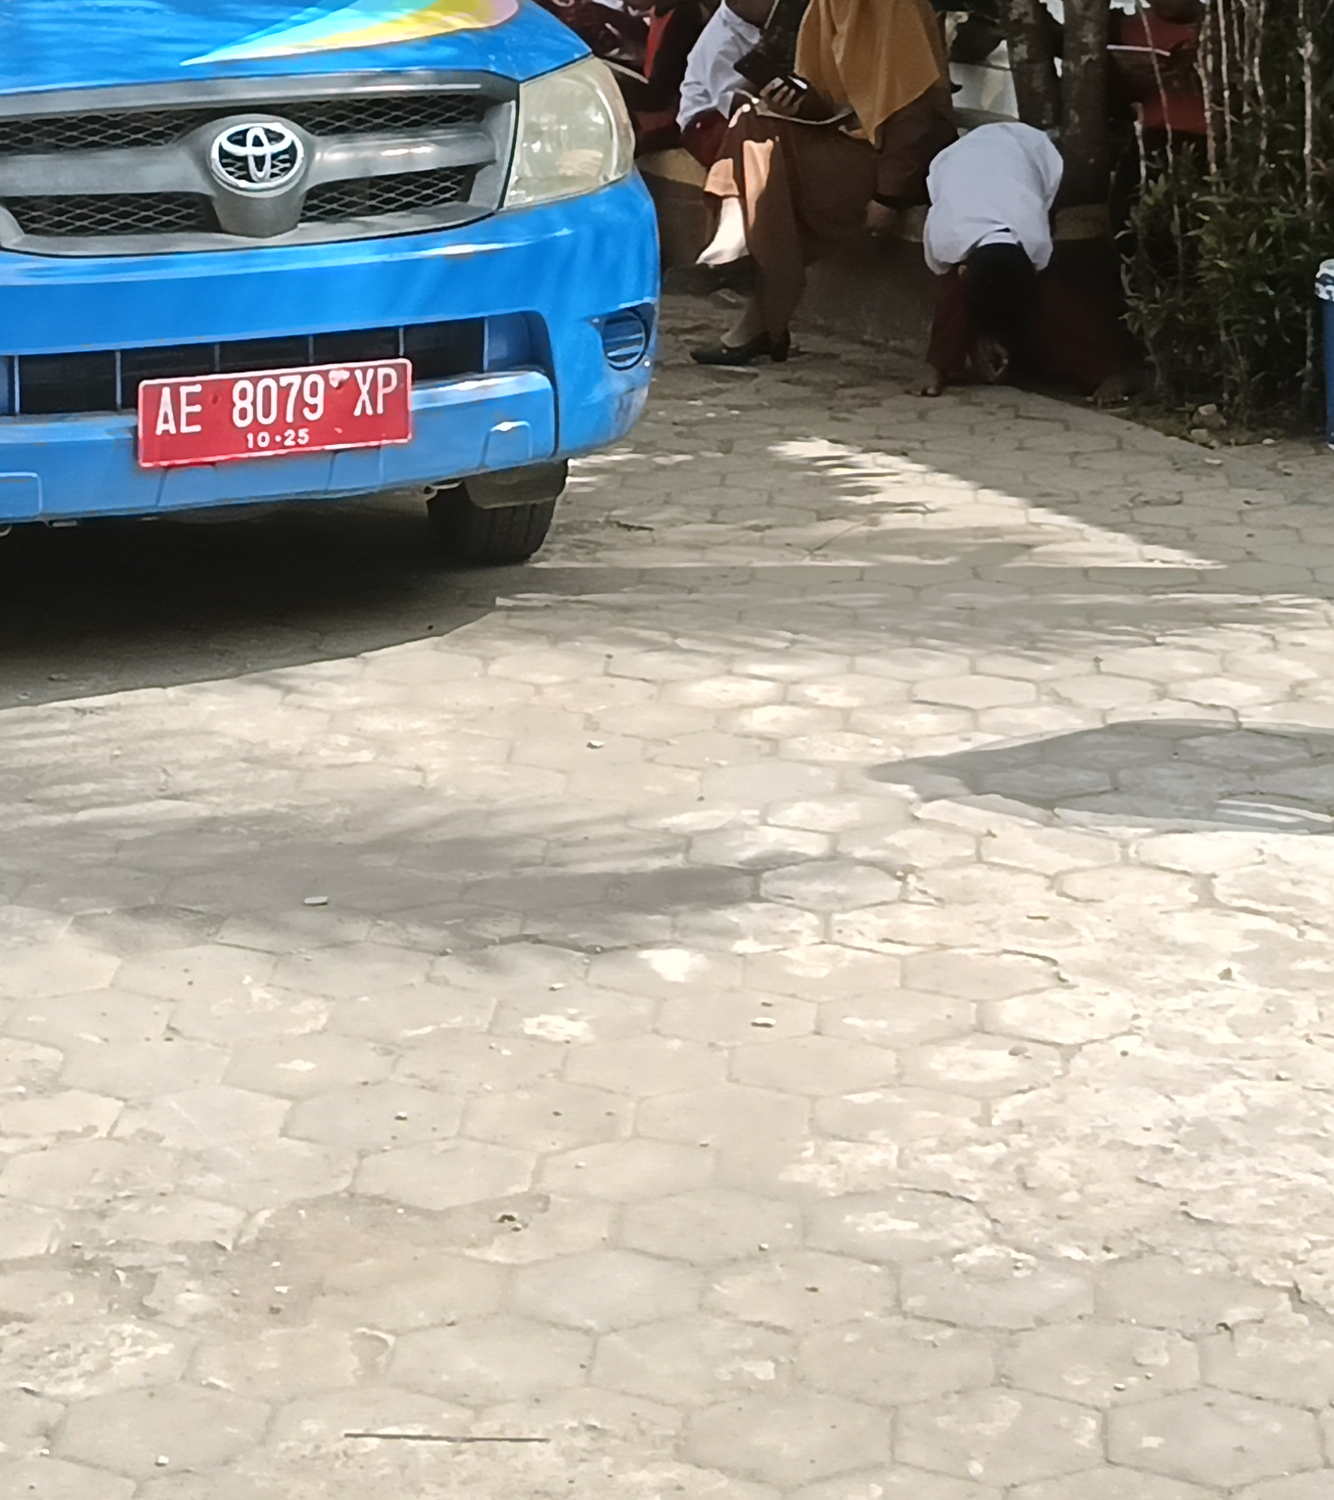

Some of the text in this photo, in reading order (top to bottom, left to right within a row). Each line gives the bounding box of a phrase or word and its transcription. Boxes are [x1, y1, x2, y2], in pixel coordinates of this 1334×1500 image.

[155, 366, 398, 436] AE 8079 XP
